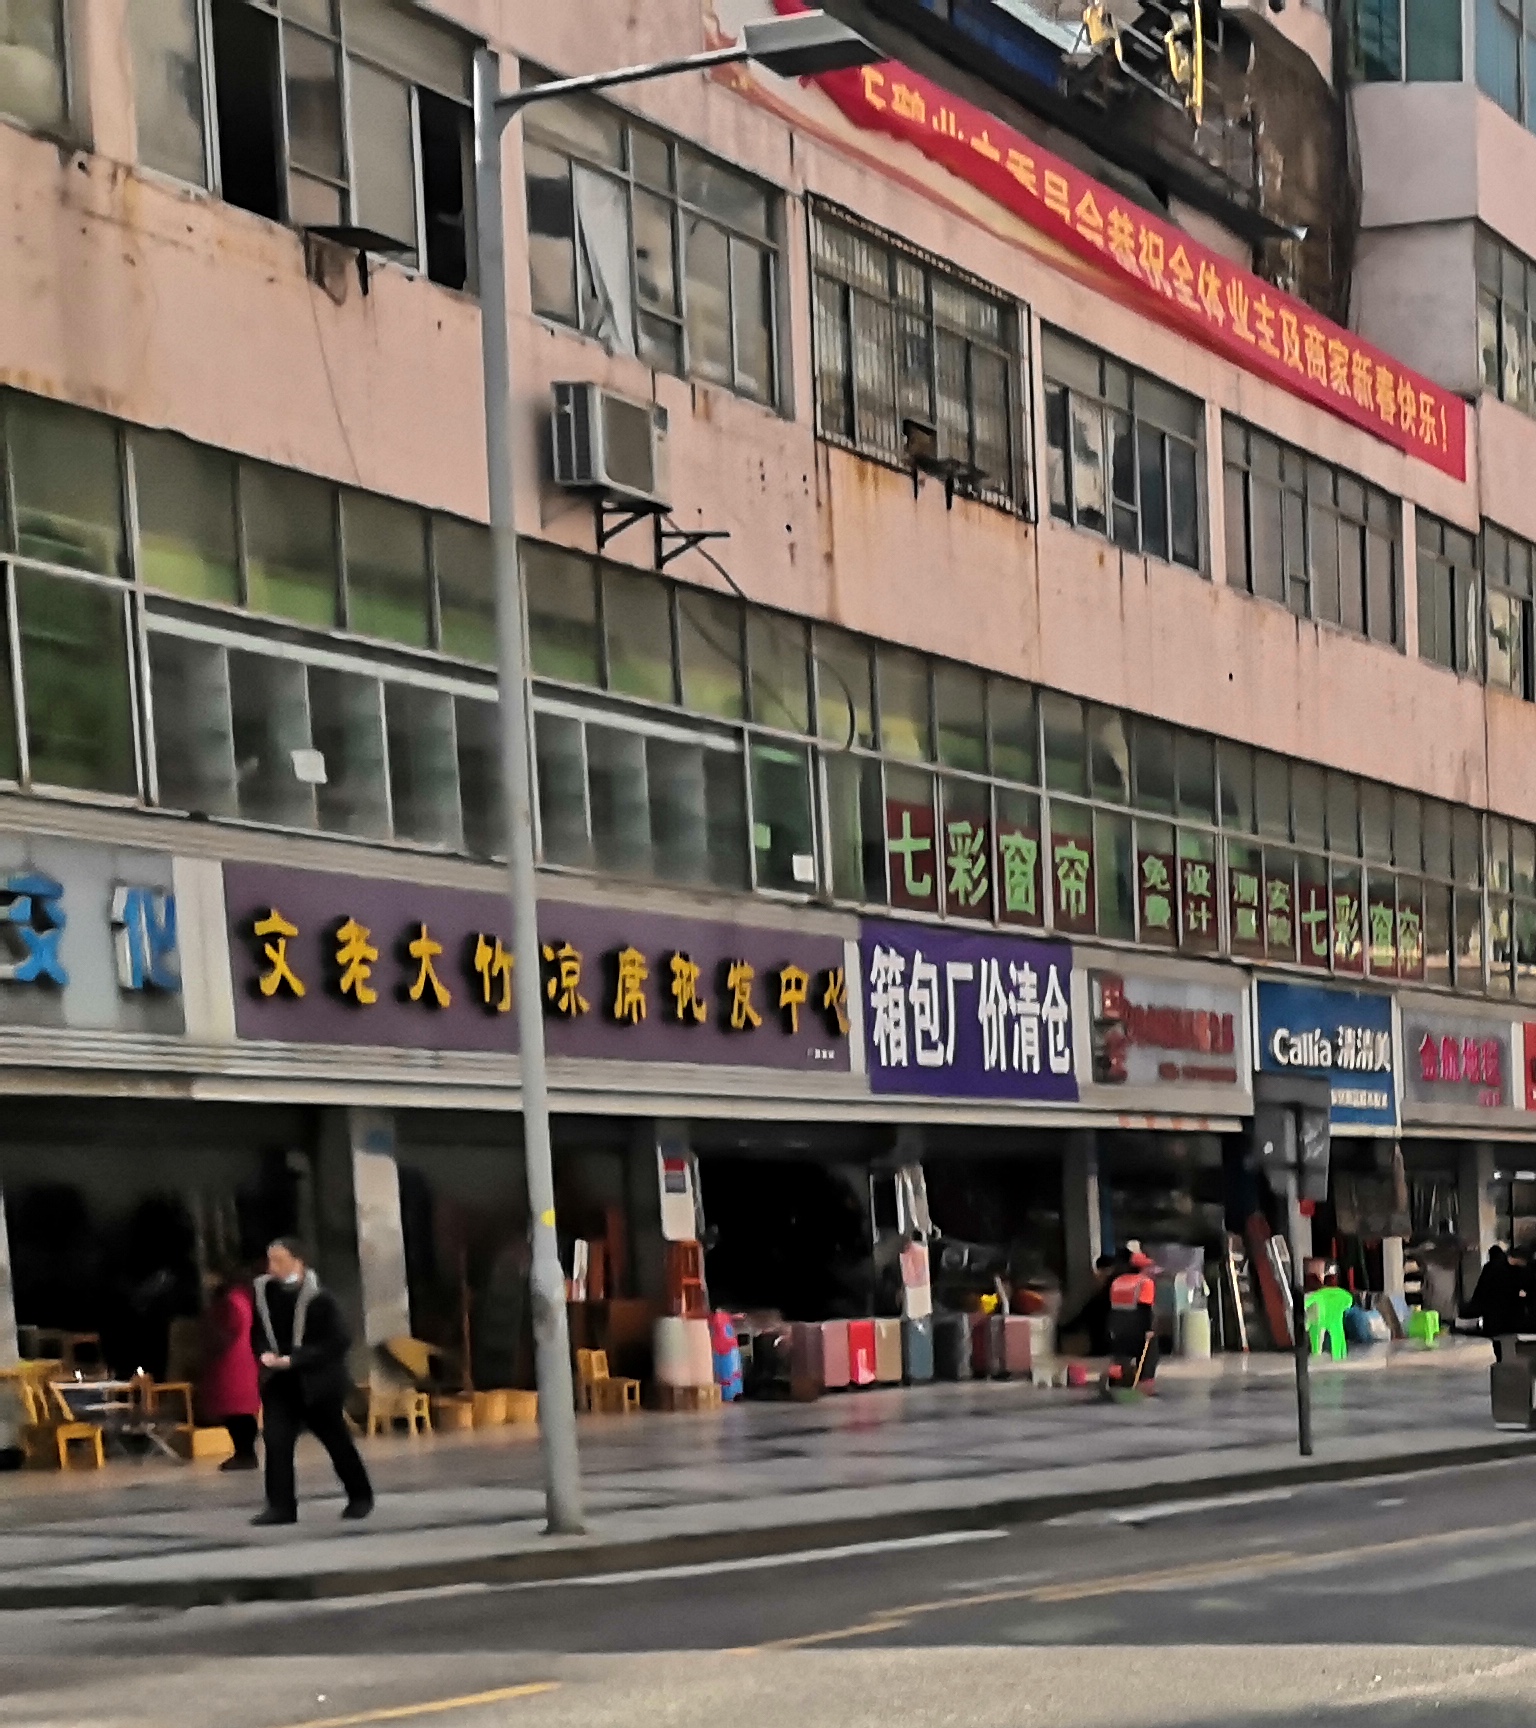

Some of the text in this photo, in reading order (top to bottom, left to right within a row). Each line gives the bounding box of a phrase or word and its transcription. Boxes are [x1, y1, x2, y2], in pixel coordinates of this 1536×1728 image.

[888, 810, 1091, 915] 七彩窗帘
[253, 907, 850, 1036] 文老大竹凉席批发中心
[870, 944, 1071, 1075] 箱包厂价清仓
